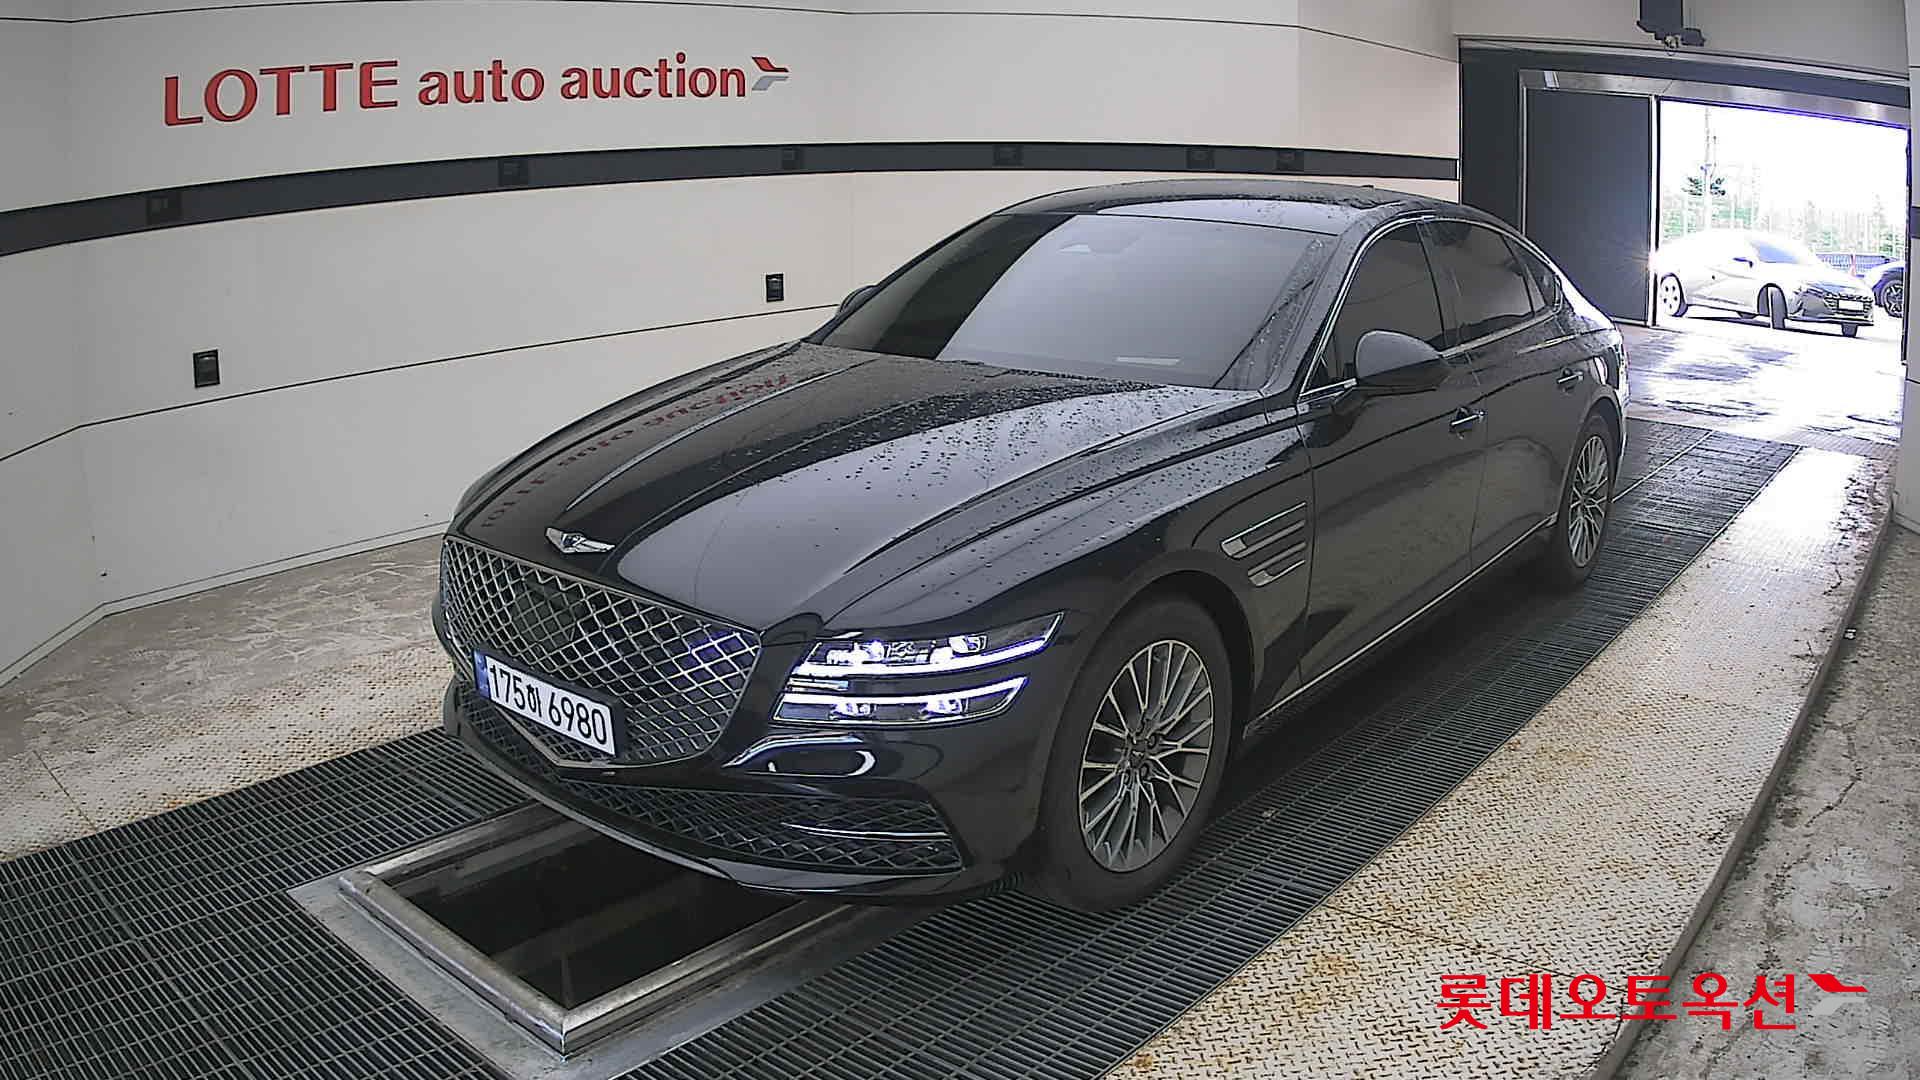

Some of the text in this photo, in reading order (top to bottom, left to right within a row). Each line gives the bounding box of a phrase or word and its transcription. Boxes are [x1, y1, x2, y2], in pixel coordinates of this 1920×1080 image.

[164, 52, 747, 126] LOTTE auto auction
[549, 691, 607, 746] 6980
